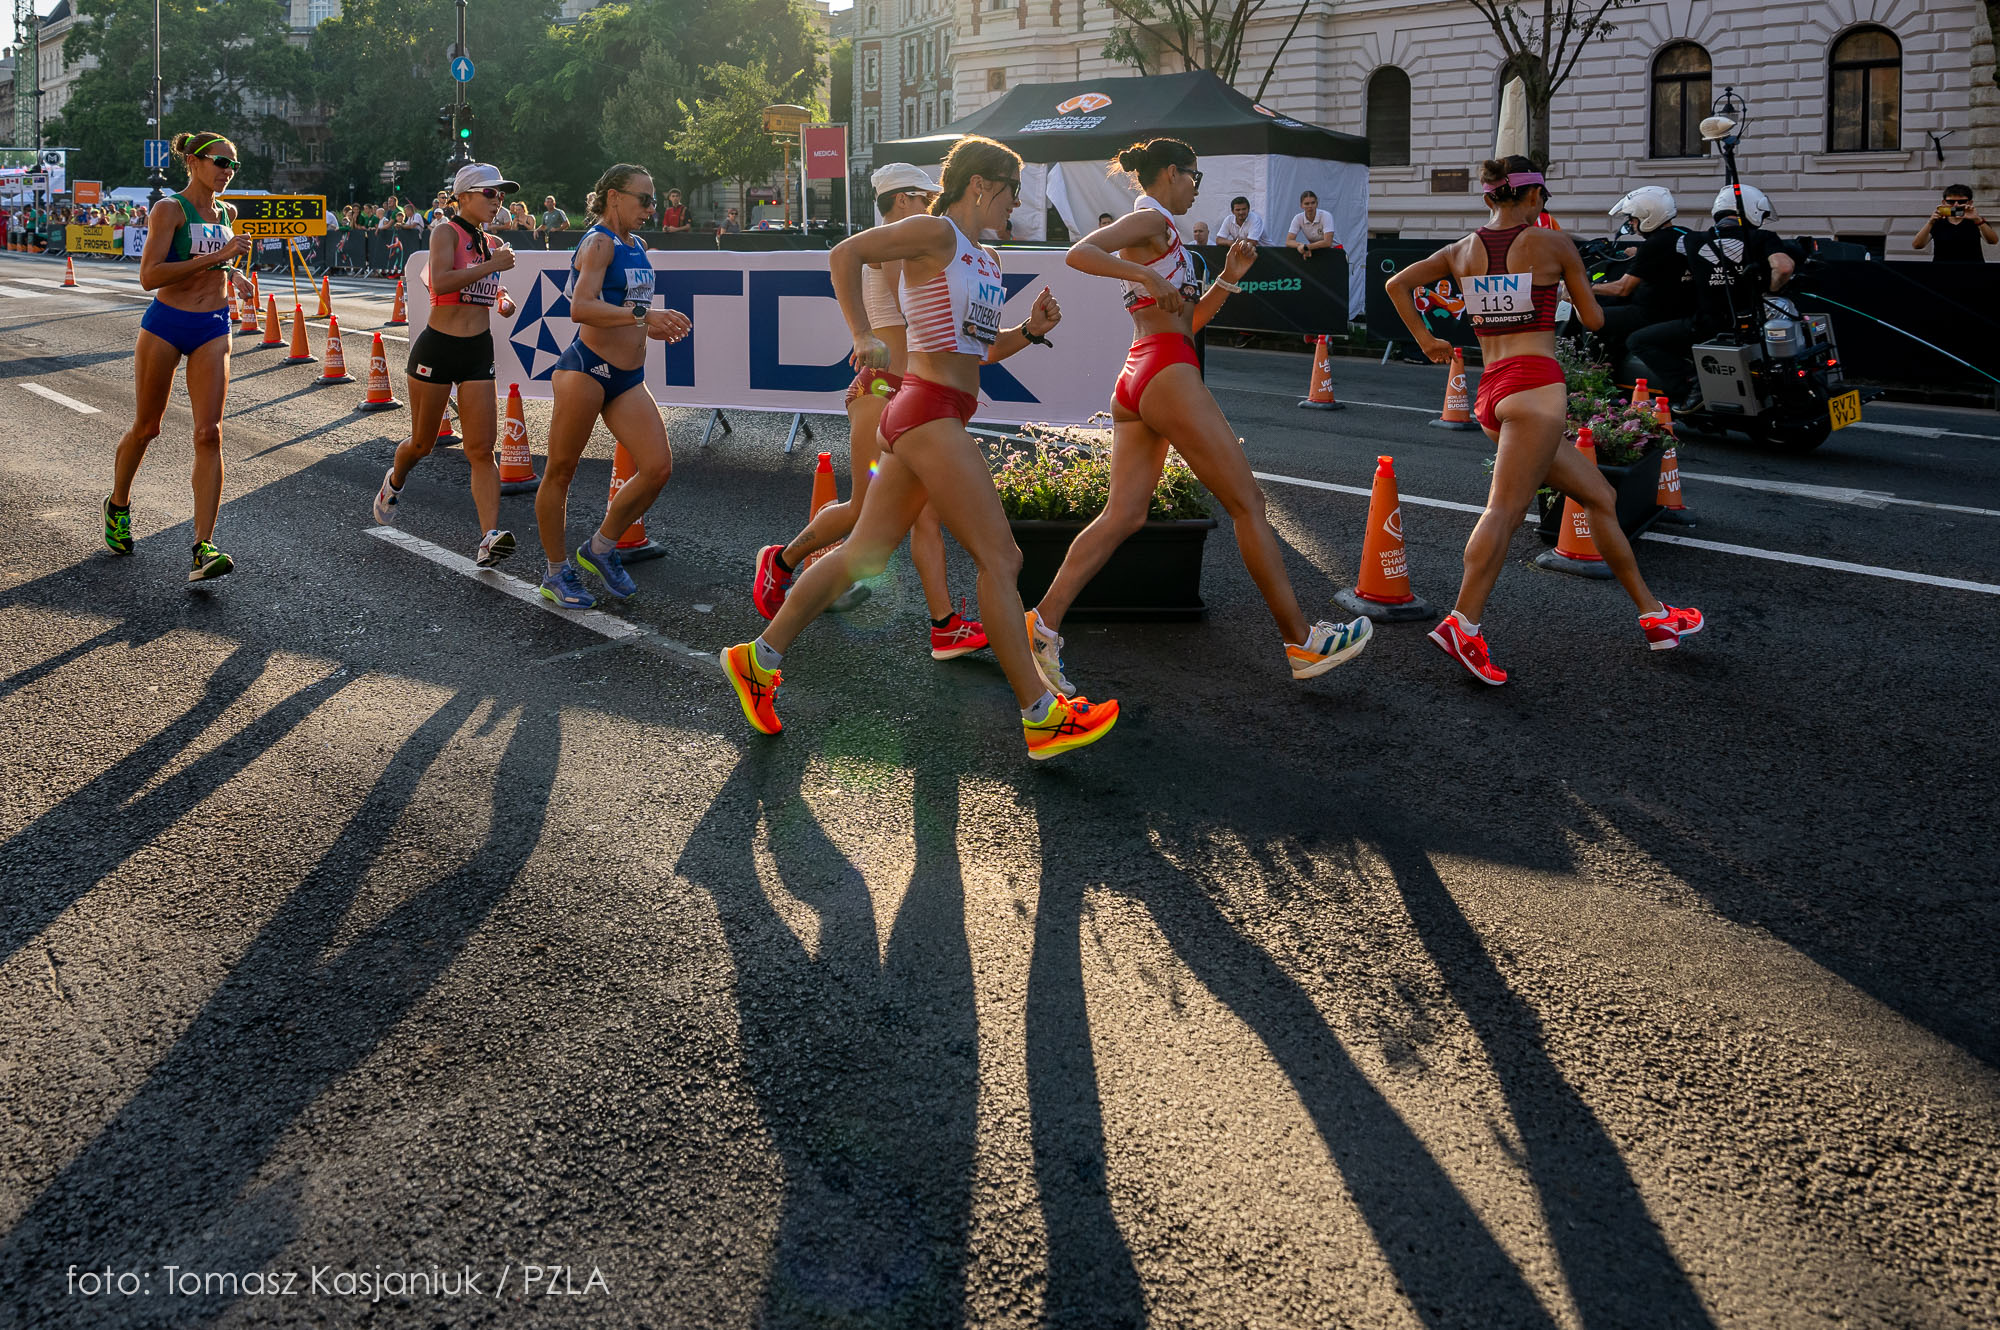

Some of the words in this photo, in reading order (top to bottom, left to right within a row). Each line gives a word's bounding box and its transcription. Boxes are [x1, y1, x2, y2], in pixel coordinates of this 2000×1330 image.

[813, 149, 839, 158] MEDICAL
[83, 226, 103, 236] SEIKO
[203, 224, 222, 238] NT
[242, 222, 307, 235] SEIKO
[84, 239, 112, 250] PROSPEX
[1474, 275, 1519, 293] NTN
[1481, 295, 1514, 312] 113
[1485, 315, 1521, 323] BUDAPEST
[1712, 365, 1736, 376] NEP
[1832, 394, 1856, 414] RV71
[1835, 407, 1856, 425] YVJ
